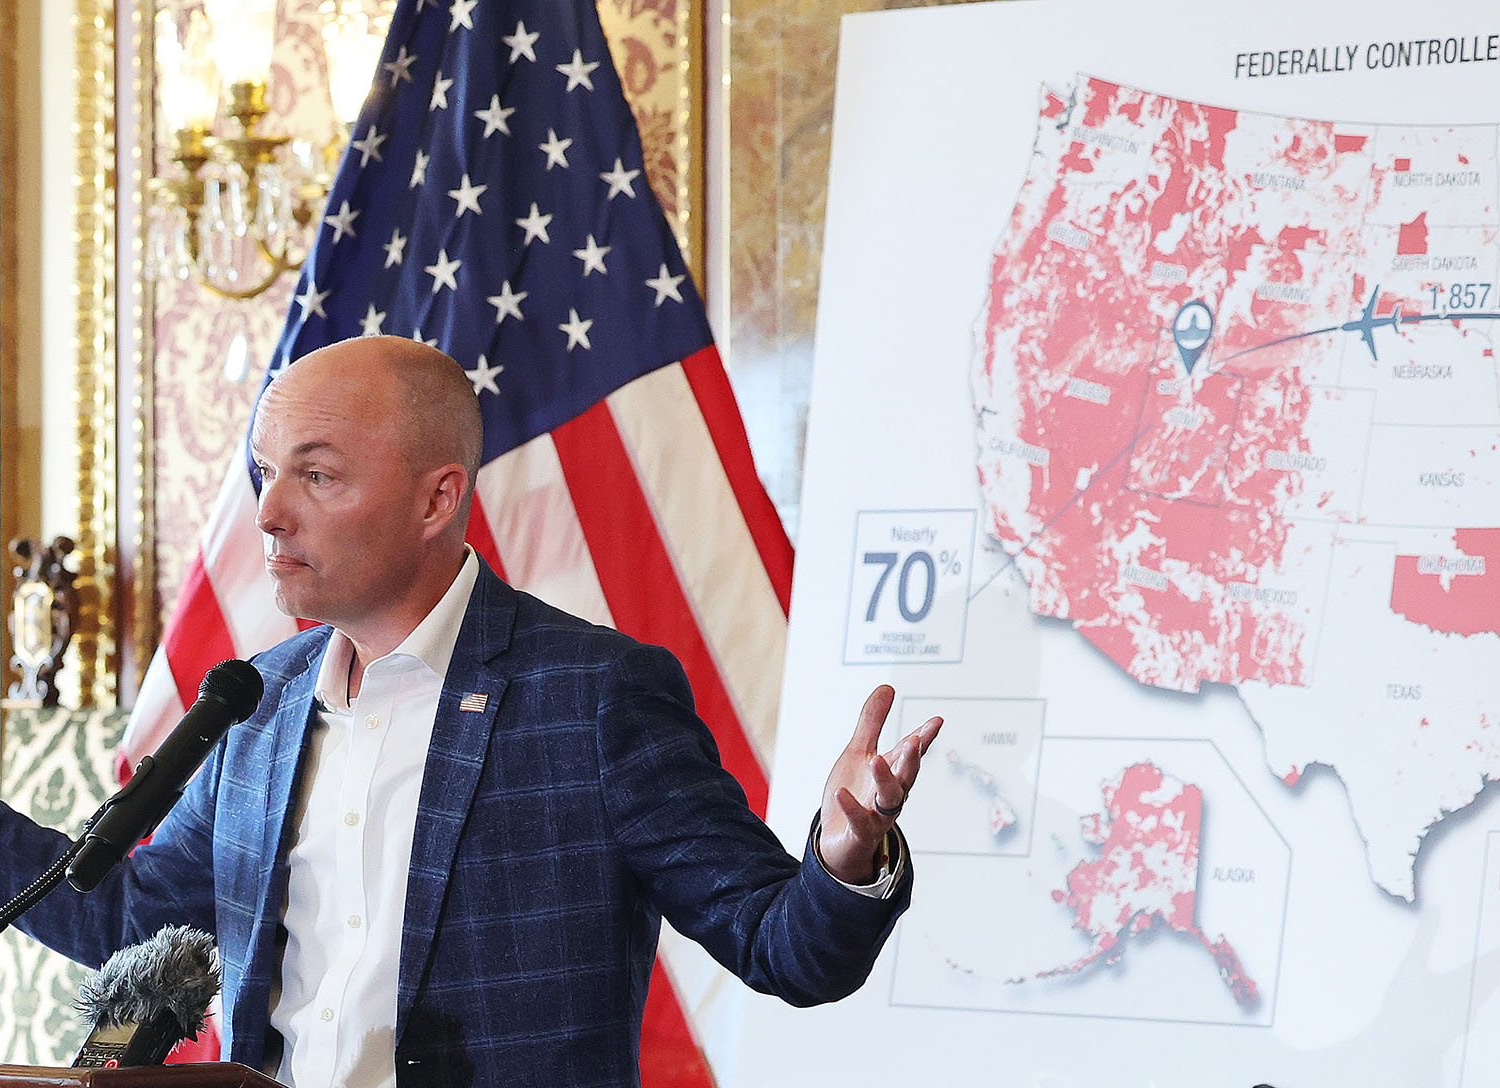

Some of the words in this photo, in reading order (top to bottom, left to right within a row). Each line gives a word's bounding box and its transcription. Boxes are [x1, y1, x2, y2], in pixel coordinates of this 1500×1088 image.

[1234, 45, 1359, 79] FEDERALLY
[1435, 171, 1481, 186] DAKOTA
[1432, 255, 1478, 271] DAKOTA
[1429, 283, 1491, 314] 1,857
[1418, 472, 1466, 488] KANSAS
[891, 526, 937, 545] Nearly
[1386, 683, 1423, 700] TEXAS
[1211, 867, 1256, 884] ALASKA
